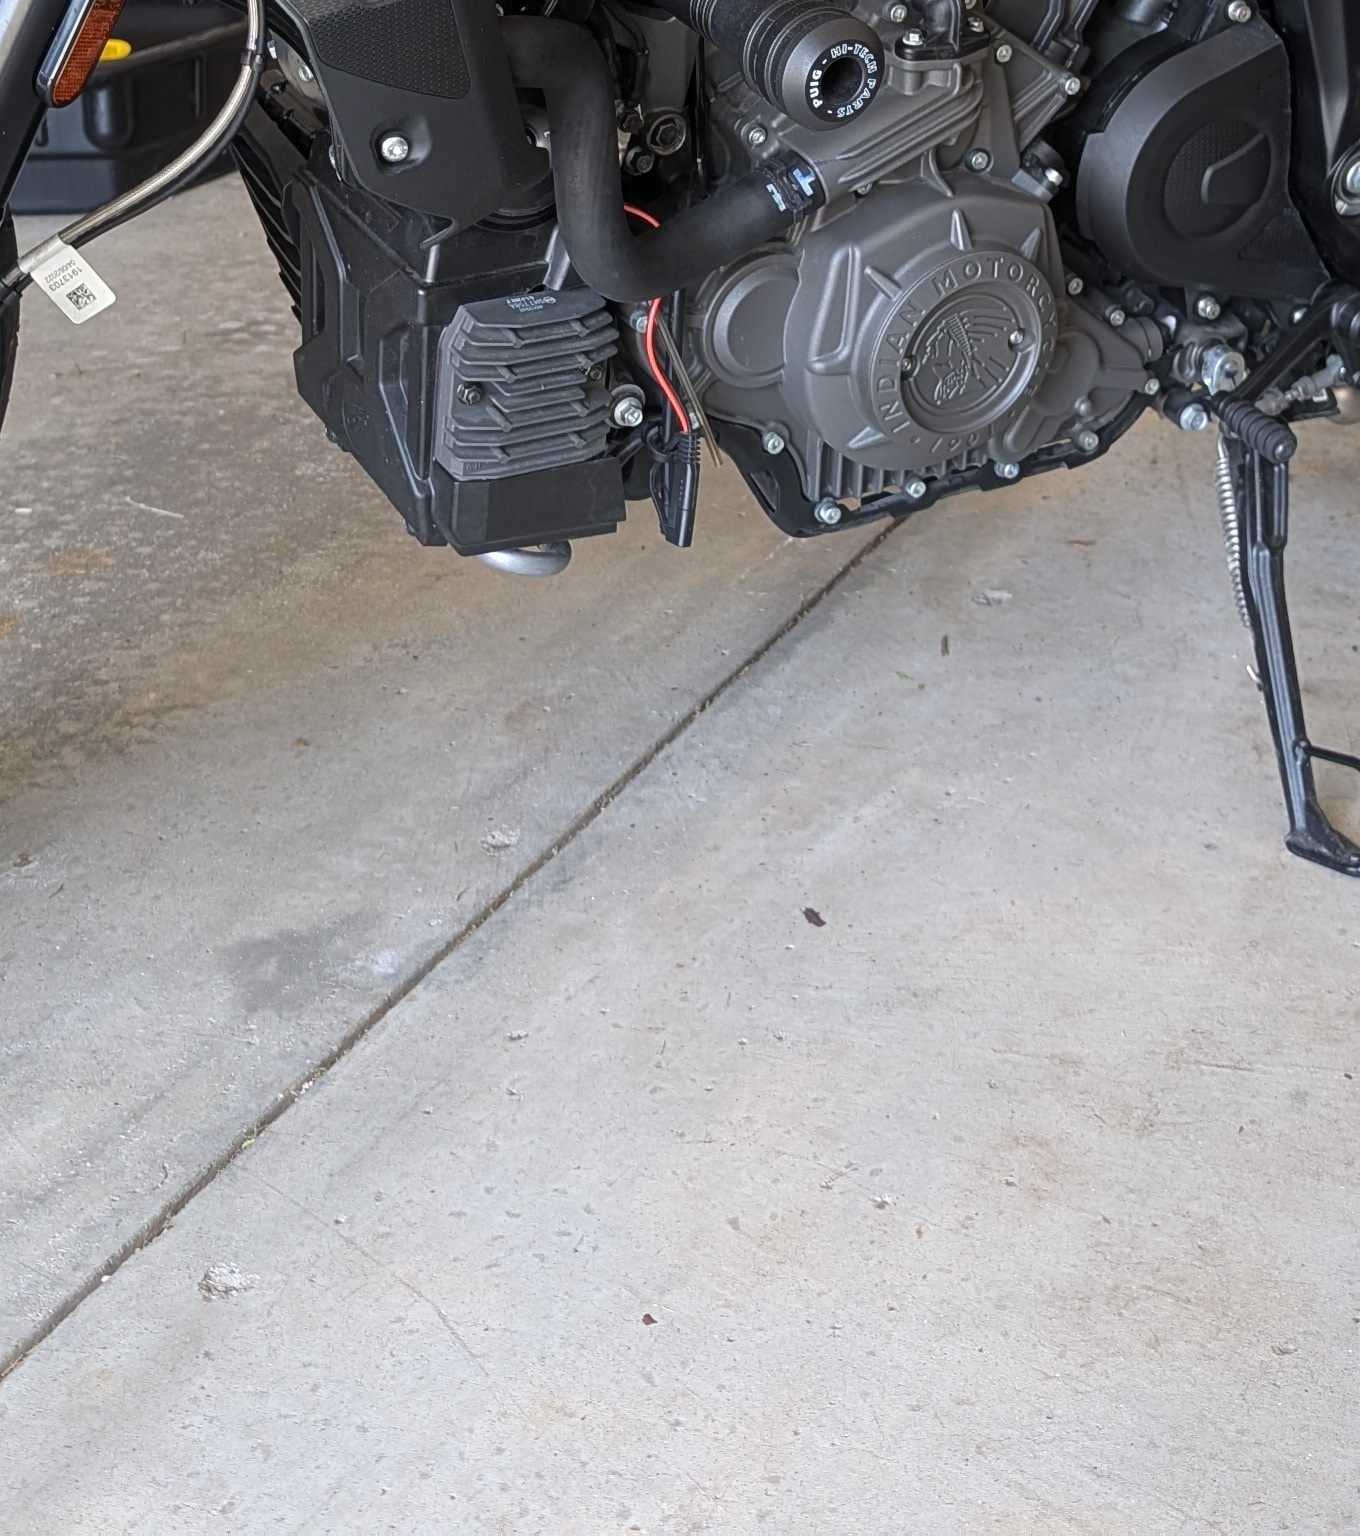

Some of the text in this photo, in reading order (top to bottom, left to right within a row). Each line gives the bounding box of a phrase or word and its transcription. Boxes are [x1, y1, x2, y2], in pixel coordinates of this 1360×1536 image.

[809, 43, 878, 118] PUIG HI-TECH PARTS
[48, 265, 83, 292] 1913703
[876, 256, 1058, 434] INDIAN MOTORCYCLE
